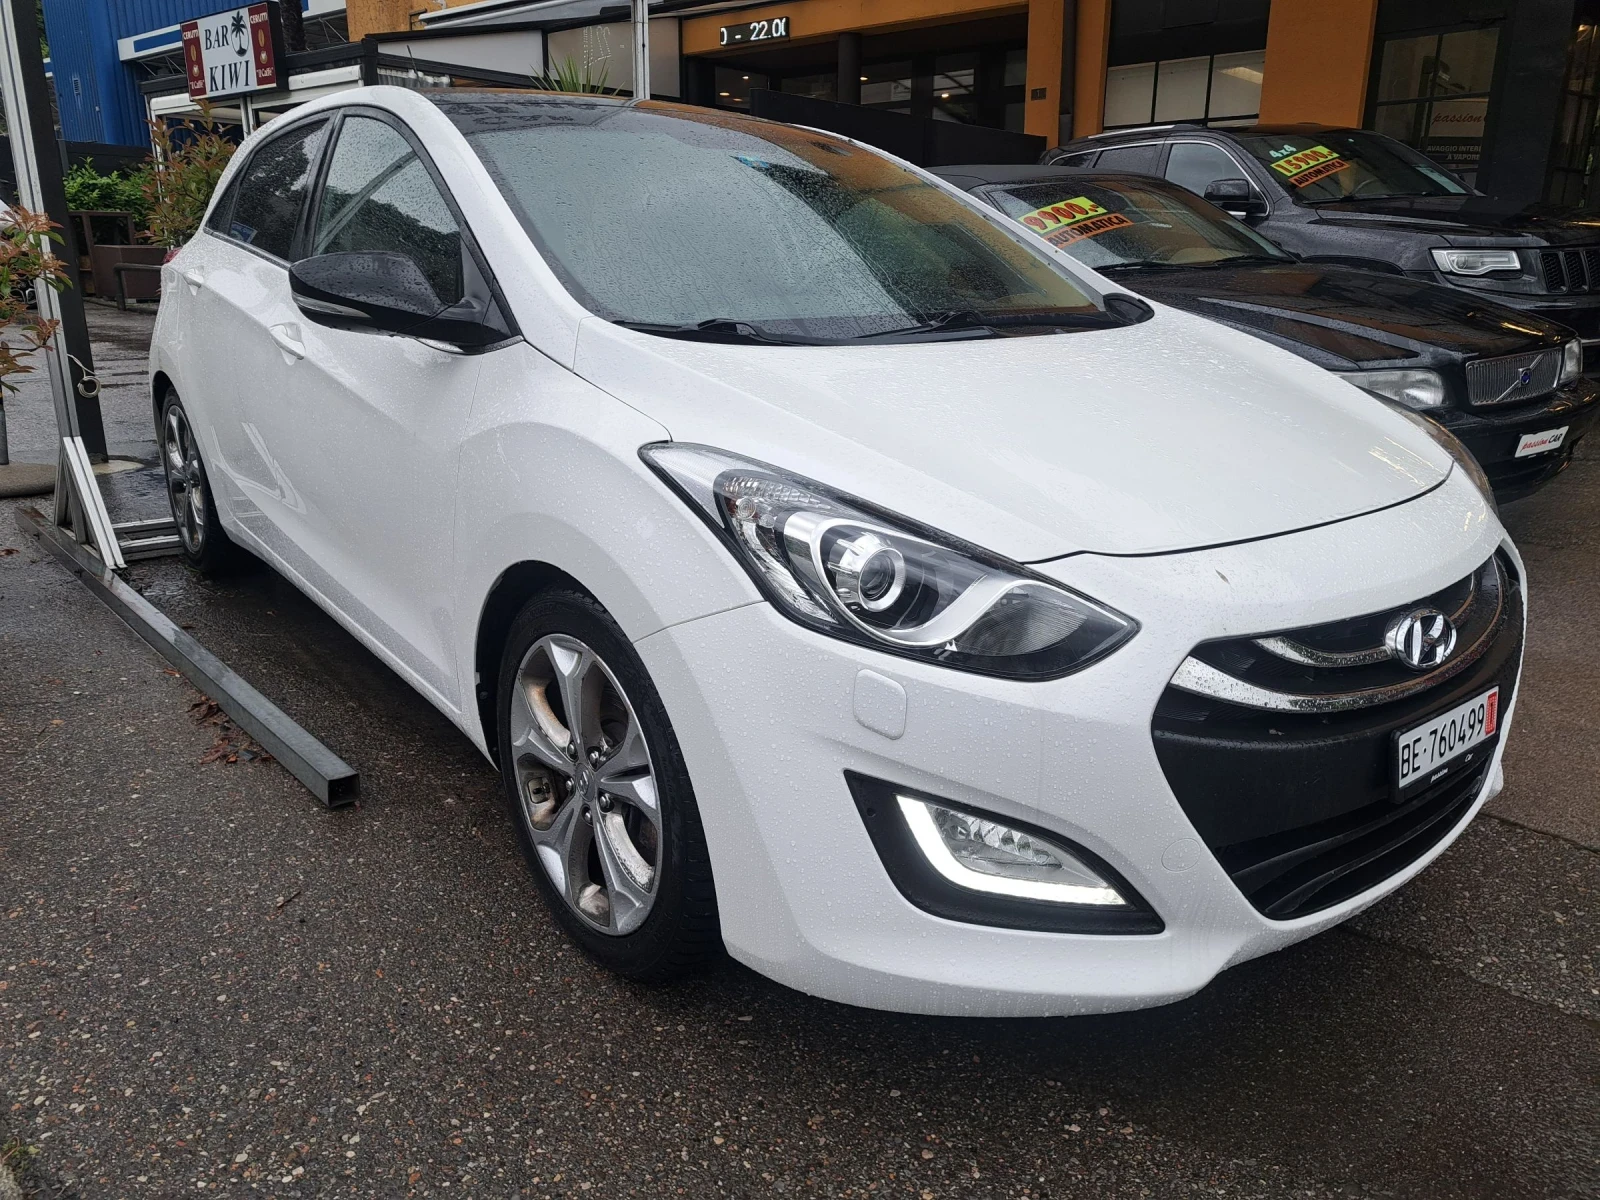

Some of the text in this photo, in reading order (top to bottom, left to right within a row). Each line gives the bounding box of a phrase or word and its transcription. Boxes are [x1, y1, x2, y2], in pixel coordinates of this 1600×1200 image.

[204, 24, 230, 51] BAR
[209, 60, 250, 93] KIWI
[1431, 112, 1482, 125] passion
[1268, 144, 1297, 158] 4x4
[1294, 160, 1345, 185] AUTOMATICA
[1047, 214, 1128, 247] AUTOMATICA
[1520, 433, 1563, 453] passion CAR
